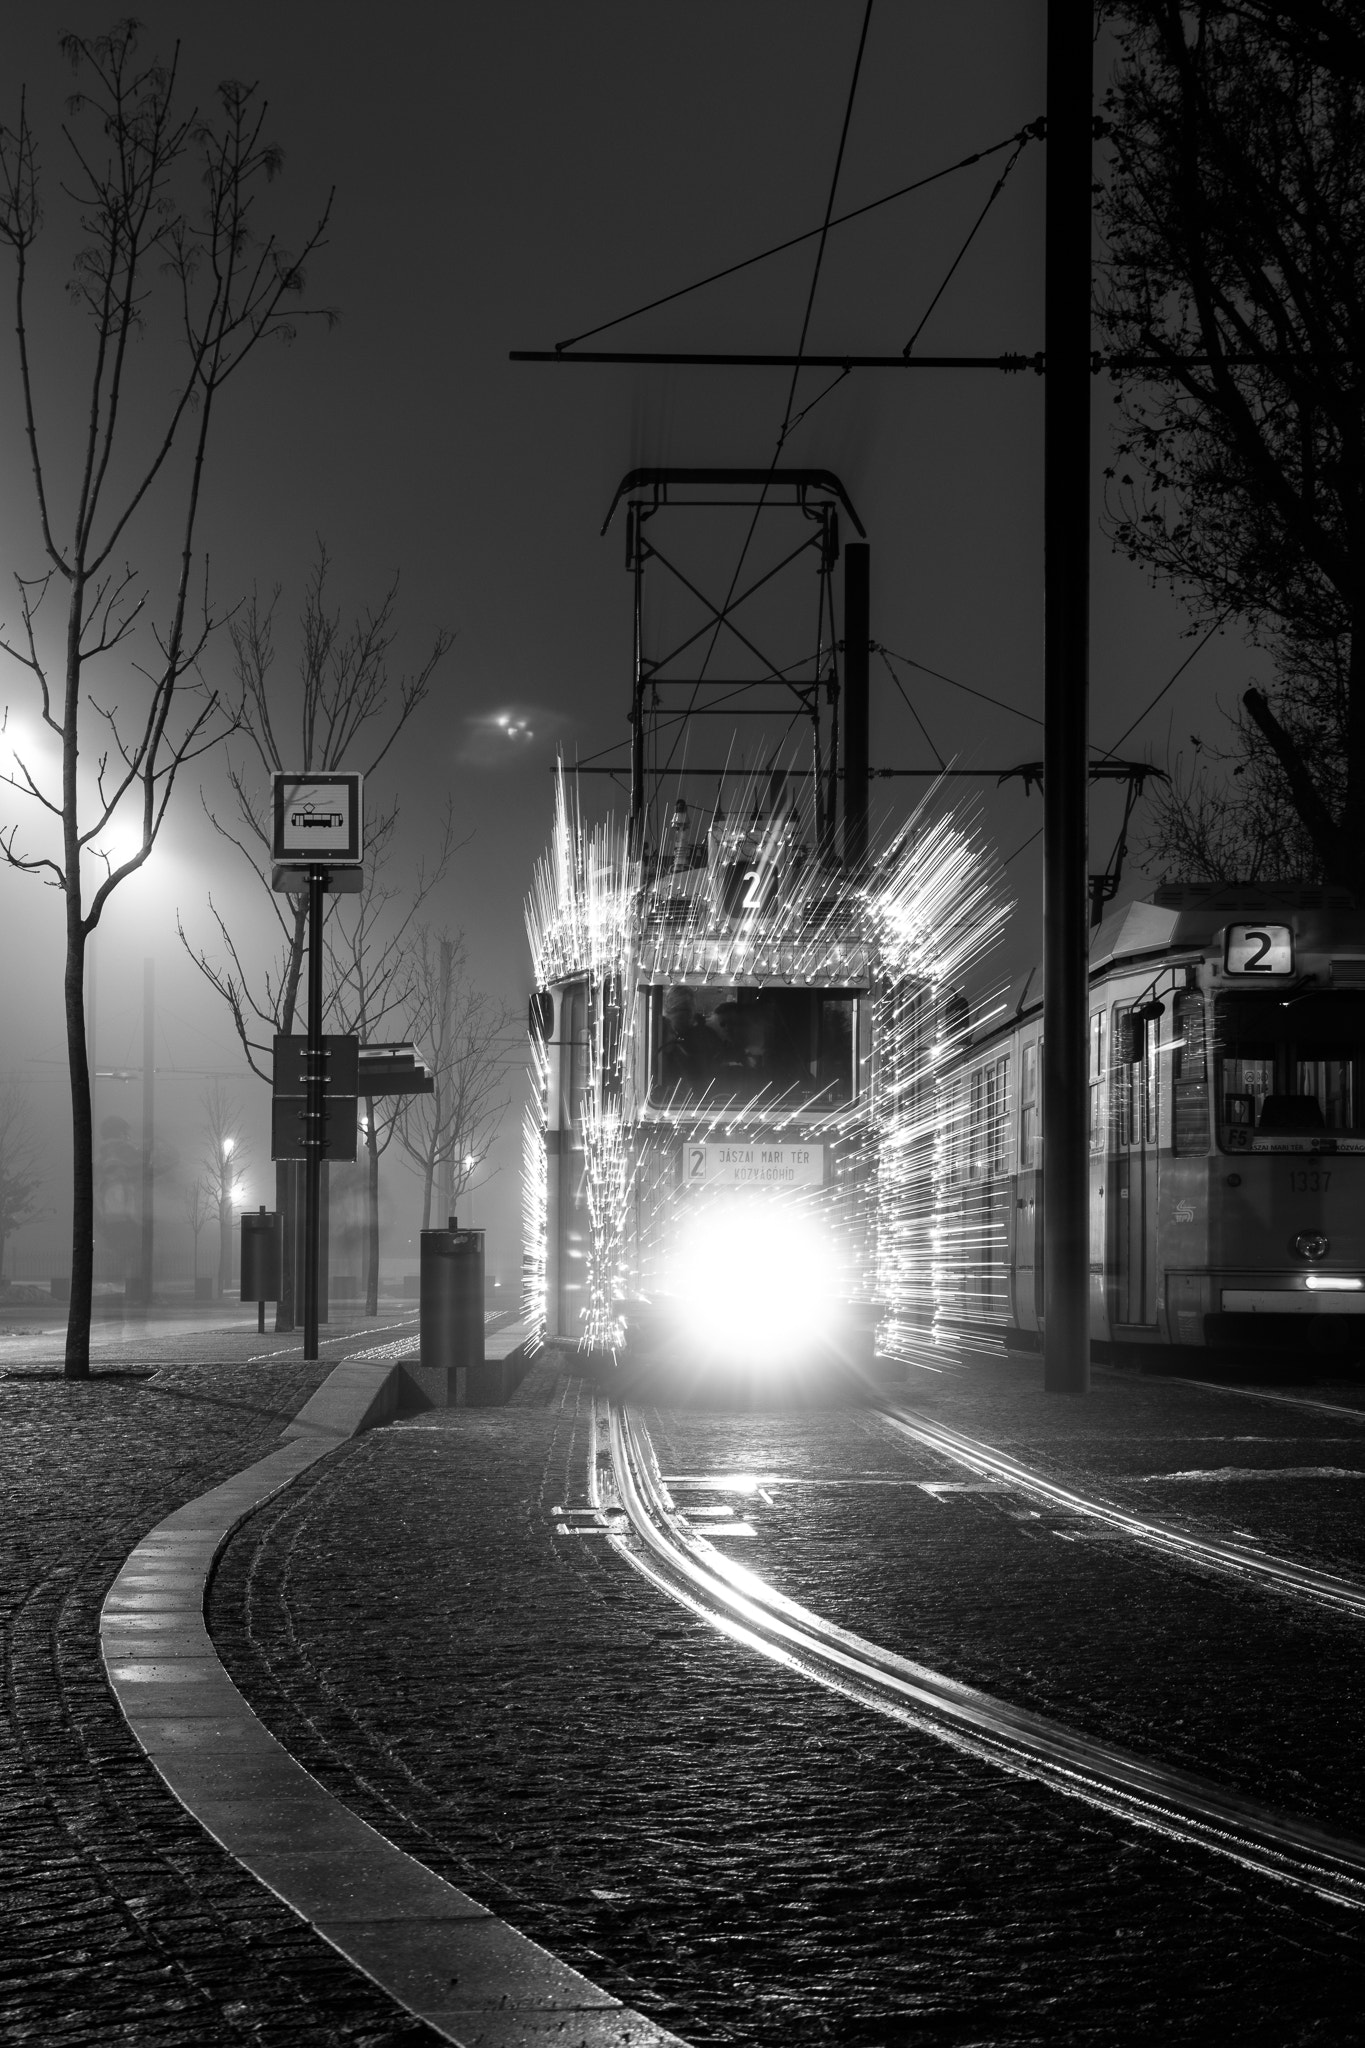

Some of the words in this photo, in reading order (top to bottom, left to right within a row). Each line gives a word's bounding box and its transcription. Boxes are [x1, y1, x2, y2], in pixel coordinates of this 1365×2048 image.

[742, 871, 761, 909] 2
[1243, 931, 1273, 971] 2
[1228, 1129, 1248, 1146] F5
[690, 1150, 704, 1177] 2
[719, 1148, 754, 1163] JÁSZAI
[761, 1151, 783, 1163] MARI
[791, 1149, 810, 1164] TÉR
[1290, 1171, 1332, 1193] 1337
